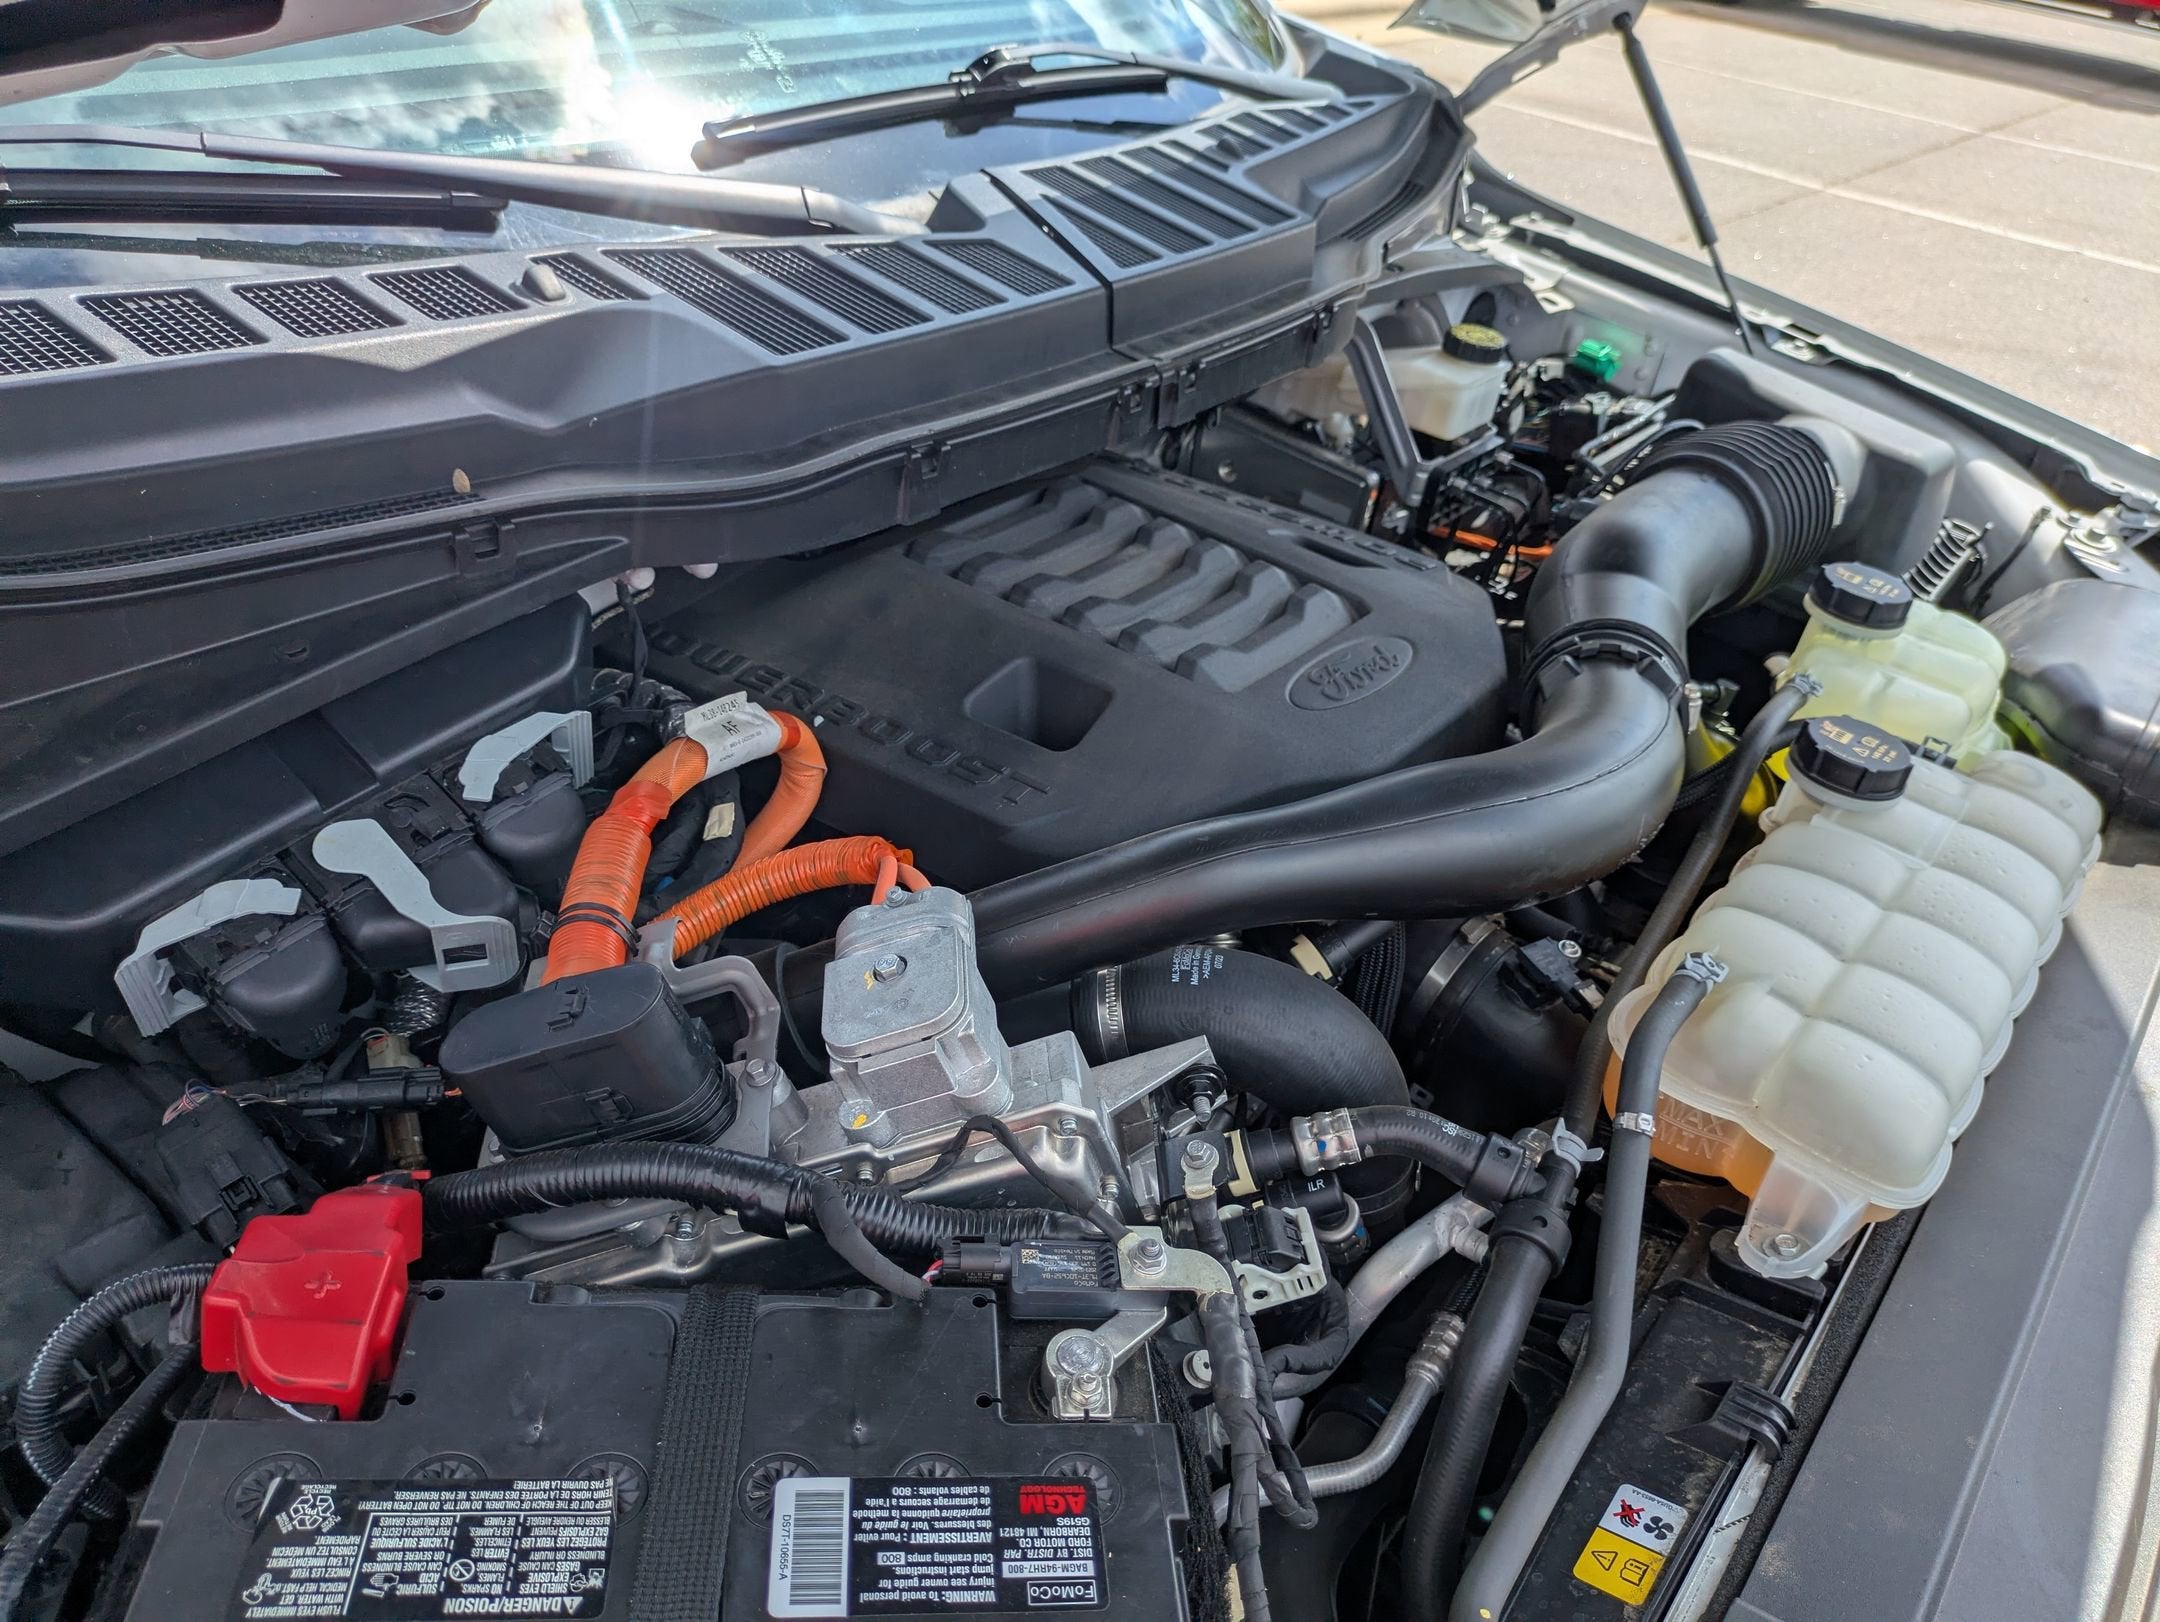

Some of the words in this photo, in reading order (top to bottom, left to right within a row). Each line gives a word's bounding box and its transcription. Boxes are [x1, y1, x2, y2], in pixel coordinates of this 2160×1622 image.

[1304, 643, 1402, 703] Ford
[646, 622, 1051, 805] OWERBOOST
[721, 720, 741, 736] AF
[1663, 1099, 1725, 1136] MAX
[1659, 1120, 1720, 1159] MIN
[1307, 1178, 1326, 1192] ILR
[513, 1480, 550, 1489] BATTERIE!
[551, 1480, 560, 1489] LA
[562, 1480, 589, 1489] OUVRIR
[590, 1479, 604, 1489] PAS
[593, 1488, 612, 1498] TENIR
[892, 1487, 912, 1495] 800
[919, 1487, 948, 1495] volants
[950, 1486, 977, 1495] cables
[979, 1486, 989, 1494] de
[1019, 1485, 1085, 1493] TECHNOLOGY
[394, 1491, 439, 1500] RENVERSER.
[441, 1491, 455, 1499] PAS
[456, 1491, 467, 1499] NE
[469, 1490, 504, 1499] ENFANTS.
[505, 1491, 519, 1499] DES
[521, 1491, 548, 1500] PORTÉE
[550, 1491, 559, 1499] LA
[560, 1490, 570, 1498] DE
[572, 1490, 592, 1498] HORS
[358, 1501, 392, 1510] BATTERY!
[394, 1501, 412, 1510] OPEN
[429, 1501, 440, 1509] DO
[442, 1501, 454, 1509] TIP.
[456, 1501, 471, 1509] NOT
[472, 1501, 482, 1509] DO
[484, 1501, 520, 1509] CHILDREN.
[521, 1500, 530, 1509] OF
[532, 1500, 555, 1508] REACH
[556, 1500, 568, 1508] THE
[570, 1500, 579, 1508] OF
[581, 1500, 594, 1508] OUT
[595, 1499, 611, 1508] KEEP
[865, 1498, 889, 1507] l'aide
[933, 1497, 978, 1505] demarrage
[980, 1497, 990, 1505] de
[1019, 1494, 1086, 1515] AGM
[414, 1502, 428, 1510] NOT
[852, 1510, 889, 1518] methode
[892, 1510, 899, 1518] la
[902, 1508, 940, 1518] quidonne
[941, 1507, 991, 1518] proprietaire
[875, 1519, 898, 1529] guide
[931, 1521, 975, 1529] blessures.
[977, 1520, 991, 1528] des
[1056, 1517, 1090, 1525] G519S
[861, 1522, 872, 1530] du
[1040, 1526, 1090, 1535] DEARBORN,
[559, 1527, 594, 1536] EXPLOSIFS
[596, 1527, 609, 1536] GAZ
[999, 1528, 1024, 1536] 48121
[1027, 1528, 1038, 1536] MI
[314, 1535, 361, 1544] RAPIDEMENT.
[370, 1537, 417, 1547] SULFURIQUE
[536, 1537, 554, 1547] YEUX
[557, 1537, 569, 1547] LES
[853, 1533, 878, 1542] eviter
[881, 1533, 900, 1542] Pour
[910, 1532, 992, 1543] AVERTISSEMENT
[1033, 1538, 1065, 1546] MOTOR
[1068, 1537, 1091, 1546] FORD
[419, 1538, 448, 1547] L'ACIDE
[521, 1538, 535, 1547] LES
[570, 1537, 607, 1549] PROTÉGEZ
[1016, 1538, 1031, 1547] CO.
[305, 1546, 316, 1555] UN
[317, 1546, 357, 1555] CONSULTEZ
[778, 1514, 792, 1581] DS7T-10655-A
[377, 1552, 403, 1560] BURNS
[404, 1551, 432, 1560] SEVERE
[434, 1551, 445, 1559] OR
[470, 1548, 483, 1557] LES
[484, 1548, 510, 1560] ÉVITER
[529, 1552, 554, 1560] INJURY
[567, 1551, 605, 1560] BLINDNESS
[1004, 1549, 1021, 1558] PAR
[1024, 1549, 1053, 1558] DISTR.
[1056, 1548, 1068, 1557] BY
[1070, 1548, 1092, 1557] DIST.
[882, 1554, 901, 1563] 800
[907, 1553, 931, 1562] amps
[933, 1552, 971, 1563] cranking
[974, 1554, 993, 1562] Cold
[362, 1562, 402, 1571] BLINDNESS
[403, 1562, 426, 1570] CAUSE
[427, 1562, 442, 1570] CAN
[476, 1562, 507, 1571] SMOKING
[517, 1562, 540, 1571] CAUSE
[541, 1562, 555, 1570] CAN
[556, 1561, 580, 1571] GASES
[892, 1566, 947, 1575] instructions.
[949, 1566, 969, 1574] start
[972, 1564, 994, 1574] jump
[1008, 1563, 1087, 1574] BAGM-94RH7-800
[290, 1569, 309, 1578] YEUX
[312, 1568, 325, 1577] LES
[326, 1568, 352, 1576] RINCEZ
[419, 1573, 440, 1582] ACID
[528, 1572, 570, 1582] EXPLOSIVE
[969, 1576, 994, 1587] injury
[319, 1582, 348, 1591] MEDICAL
[878, 1579, 891, 1588] for
[894, 1577, 918, 1588] guide
[920, 1578, 948, 1587] owner
[951, 1578, 967, 1586] see
[300, 1583, 318, 1592] HELP
[396, 1584, 437, 1594] SULFURIC
[491, 1584, 502, 1594] NO
[519, 1584, 539, 1594] EYES
[540, 1583, 568, 1593] SHIELD
[1030, 1585, 1093, 1599] FoMoCo
[279, 1594, 294, 1604] GET
[297, 1594, 323, 1603] WATER.
[324, 1594, 344, 1603] WITH
[859, 1590, 899, 1602] personal
[902, 1592, 926, 1601] avoid
[928, 1591, 939, 1601] To
[941, 1591, 995, 1602] WARNING:
[443, 1596, 562, 1614] DANGER/POISON
[245, 1606, 297, 1618] IMMEDIATELY
[298, 1606, 316, 1616] EYES
[317, 1605, 341, 1615] FLUSH
